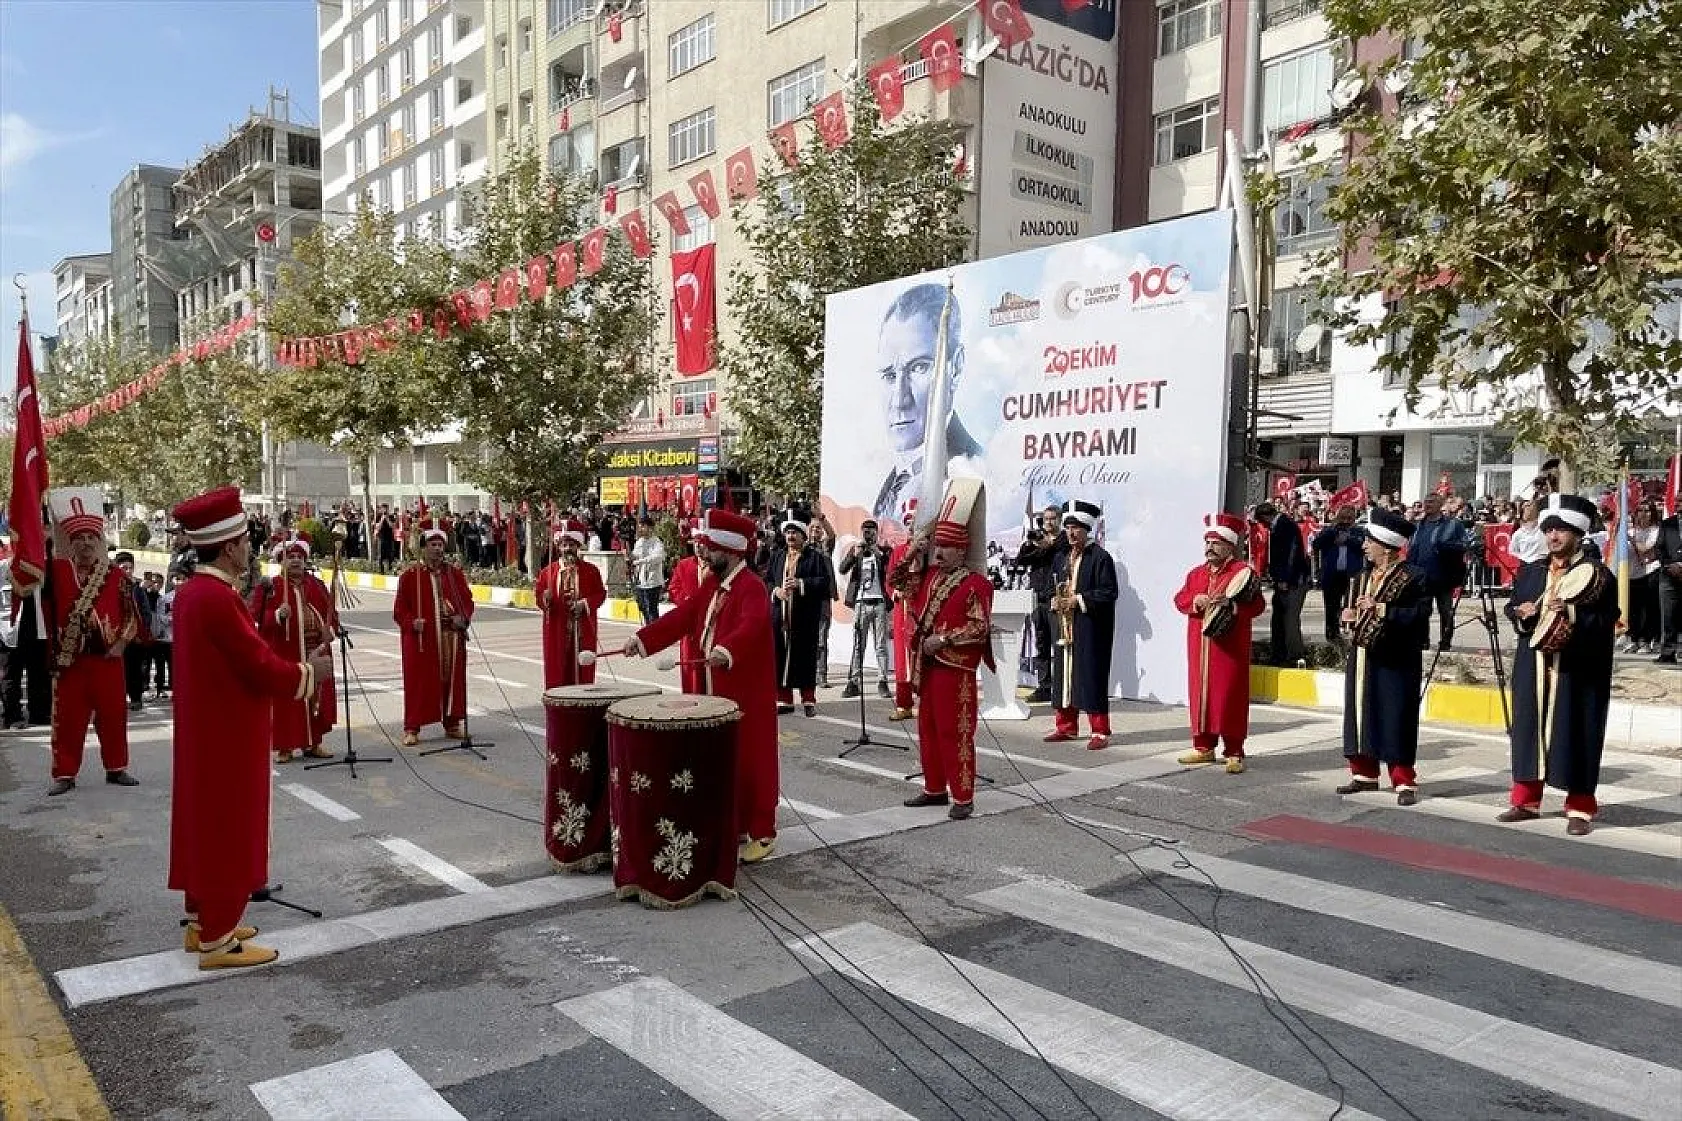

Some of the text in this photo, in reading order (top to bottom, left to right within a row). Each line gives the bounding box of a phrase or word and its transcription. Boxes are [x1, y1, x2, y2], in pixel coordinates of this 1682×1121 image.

[1019, 102, 1087, 135] ANAOKULU
[1026, 133, 1077, 171] İLKOKUL
[1017, 177, 1083, 207] ORTAOKUL
[1019, 220, 1079, 236] ANADOLU
[1003, 377, 1167, 421] CUMHURİYET
[643, 447, 696, 467] Kitabevi
[1023, 427, 1137, 460] BAYRAMI
[1079, 462, 1131, 485] Olsun
